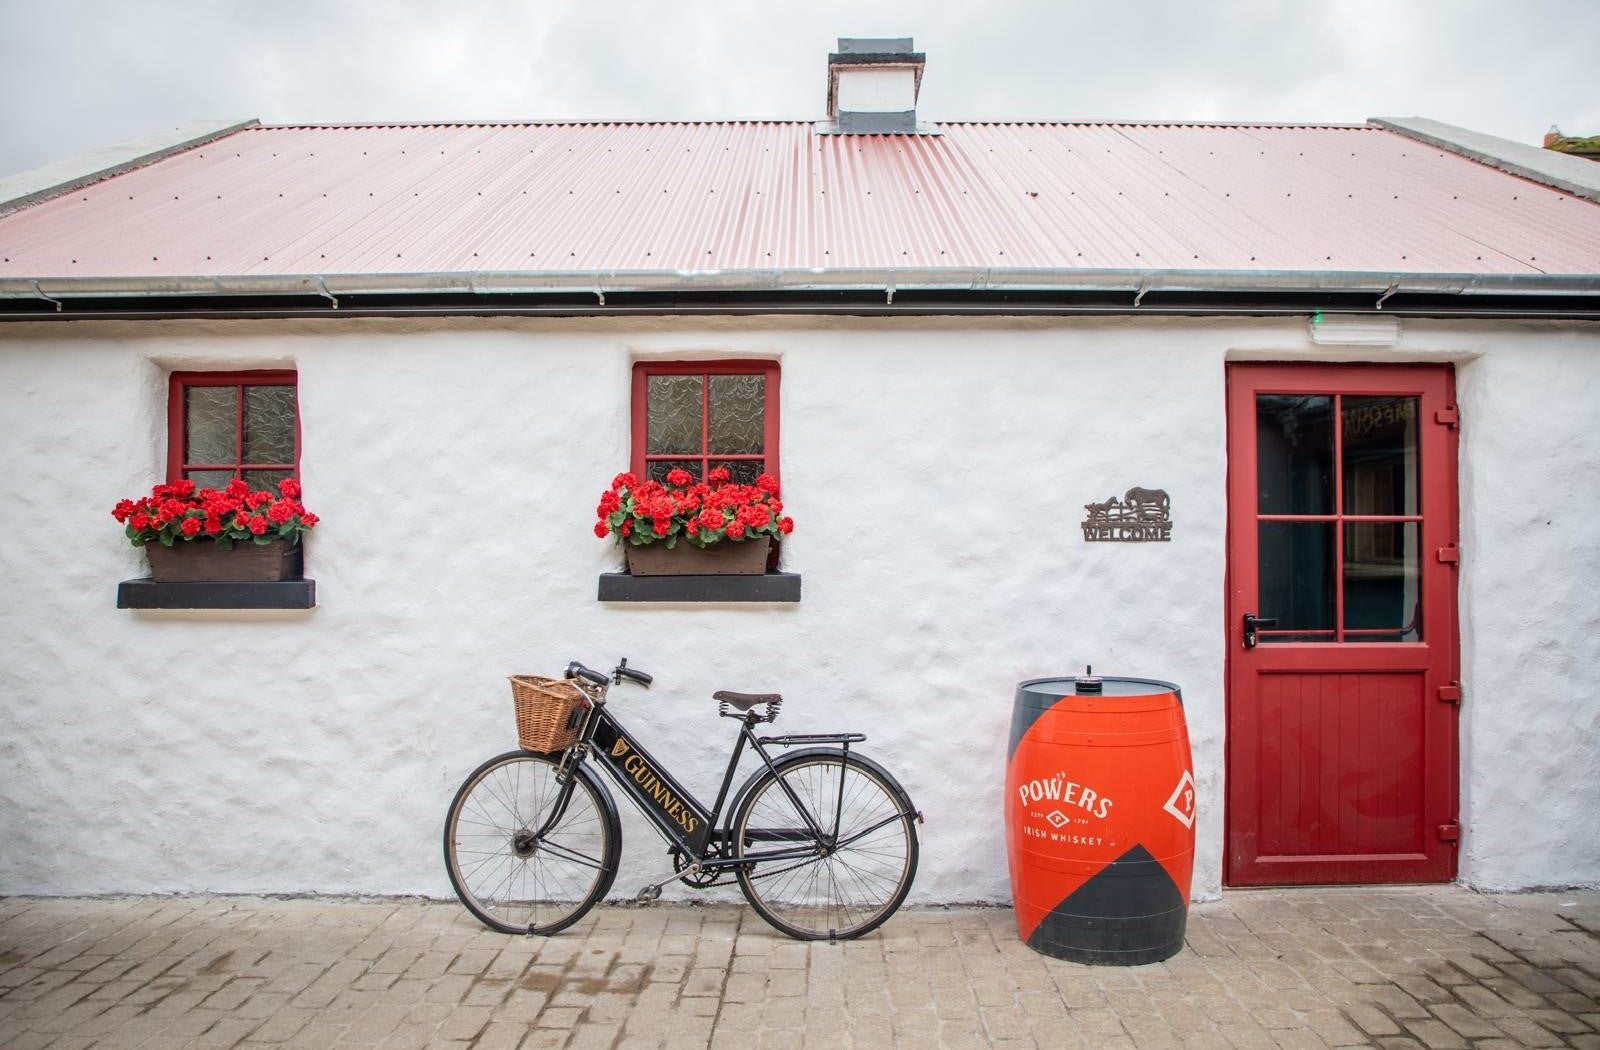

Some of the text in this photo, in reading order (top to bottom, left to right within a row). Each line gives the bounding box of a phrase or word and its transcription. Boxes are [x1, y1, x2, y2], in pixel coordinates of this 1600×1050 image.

[1083, 526, 1171, 542] WELCOME
[624, 754, 699, 833] GUINNESS
[1018, 777, 1113, 819] POWERS
[1023, 826, 1103, 846] IRISH WHISKEY
